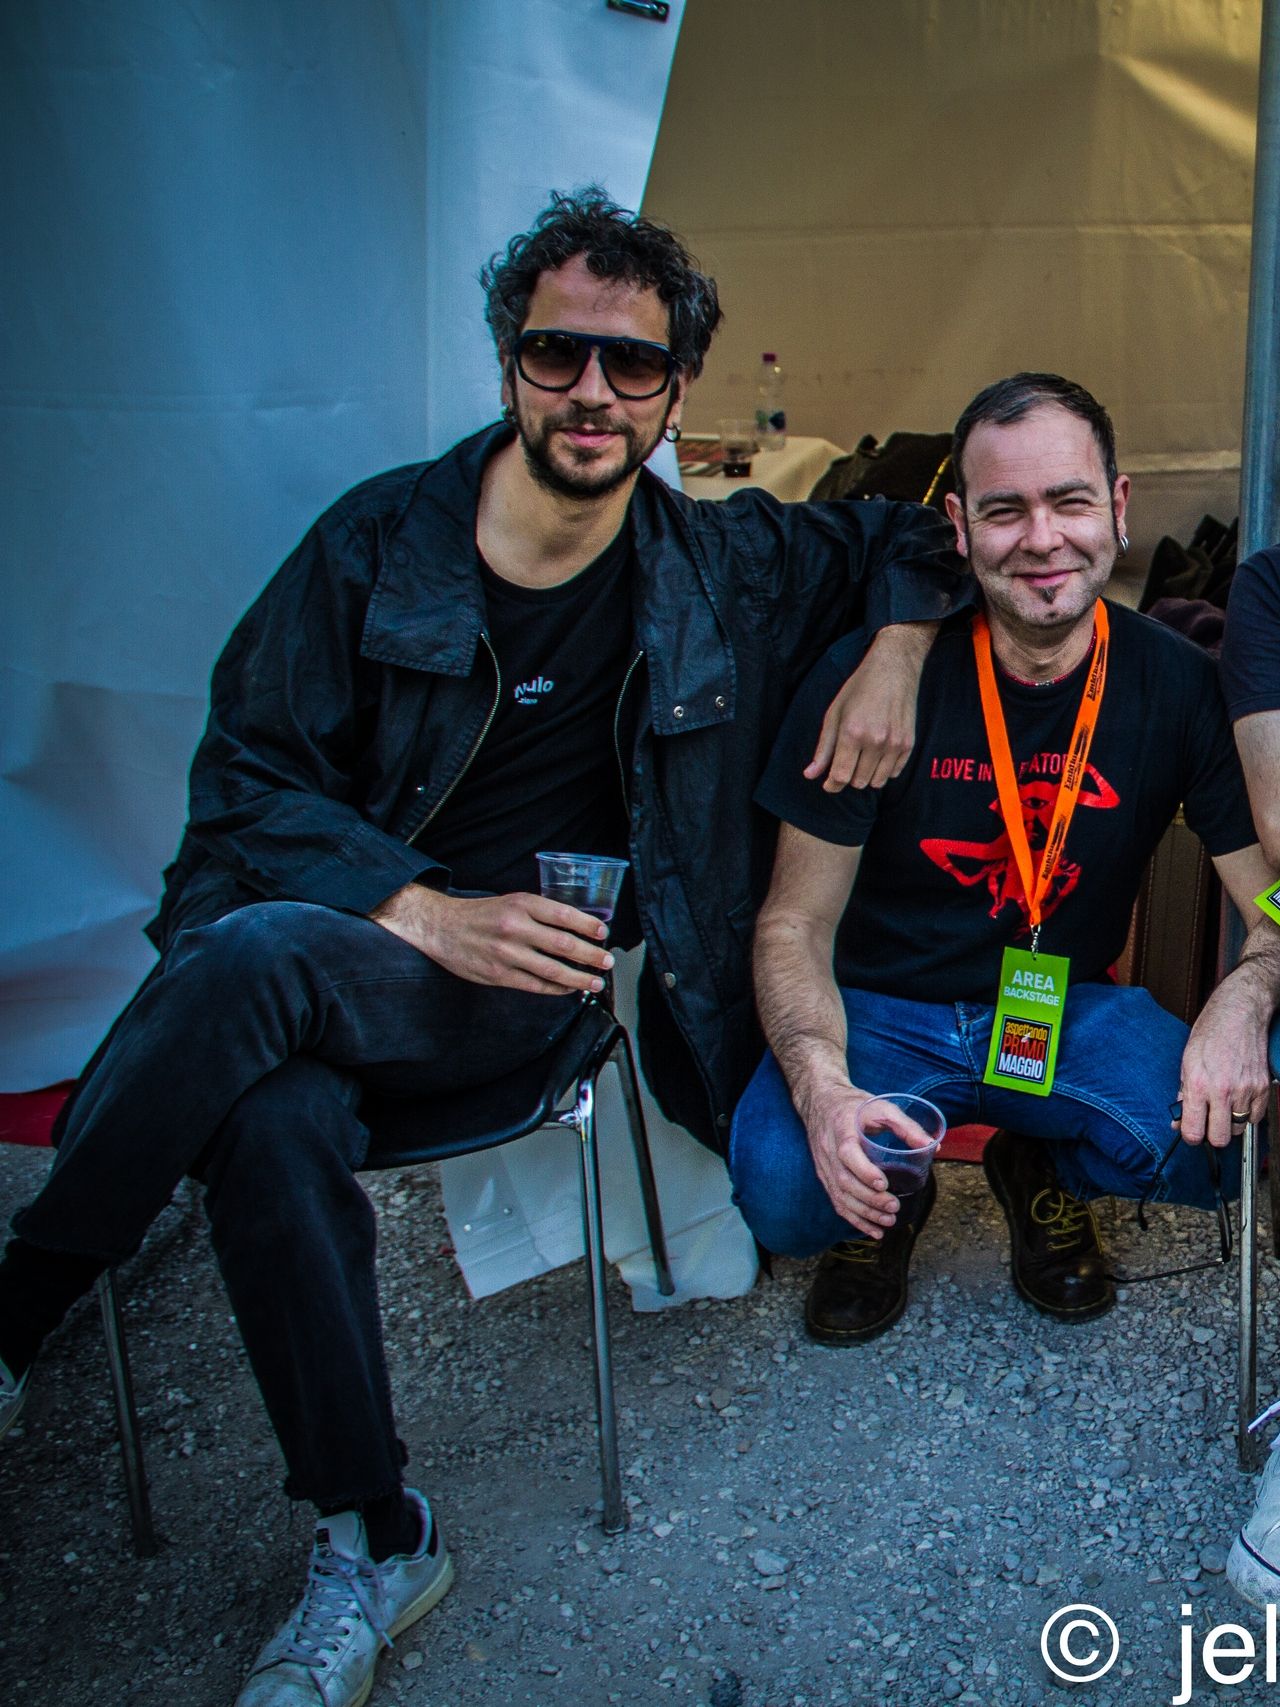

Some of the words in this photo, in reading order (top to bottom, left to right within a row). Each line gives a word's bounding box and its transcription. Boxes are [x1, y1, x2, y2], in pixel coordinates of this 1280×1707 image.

[930, 758, 976, 781] LOVE
[978, 763, 993, 782] IN
[1011, 969, 1055, 992] AREA
[1004, 986, 1060, 1007] BACKSTAGE
[1005, 1022, 1048, 1041] aspettando
[1002, 1034, 1045, 1060] PRIMO
[999, 1052, 1044, 1079] MAGGIO
